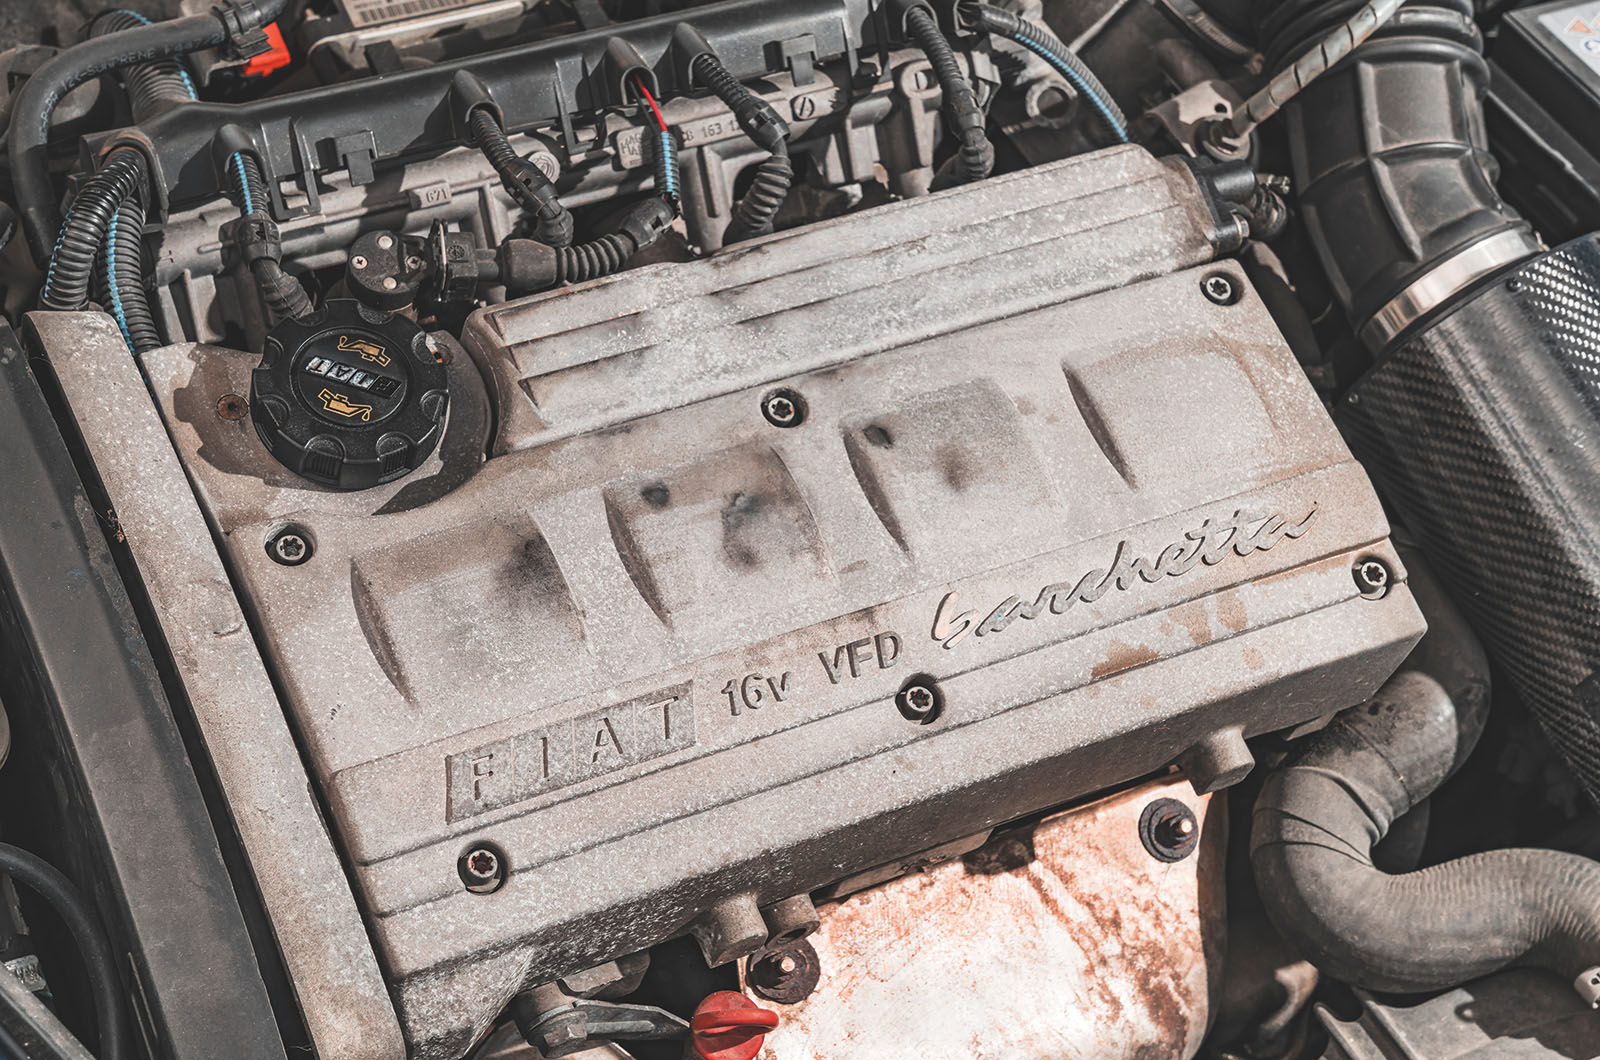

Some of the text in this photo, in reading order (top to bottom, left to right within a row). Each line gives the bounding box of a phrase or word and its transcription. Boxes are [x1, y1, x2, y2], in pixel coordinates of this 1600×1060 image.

[702, 122, 723, 138] 163
[307, 357, 398, 396] FIAT
[470, 694, 681, 801] FIAT
[816, 630, 905, 685] VFD
